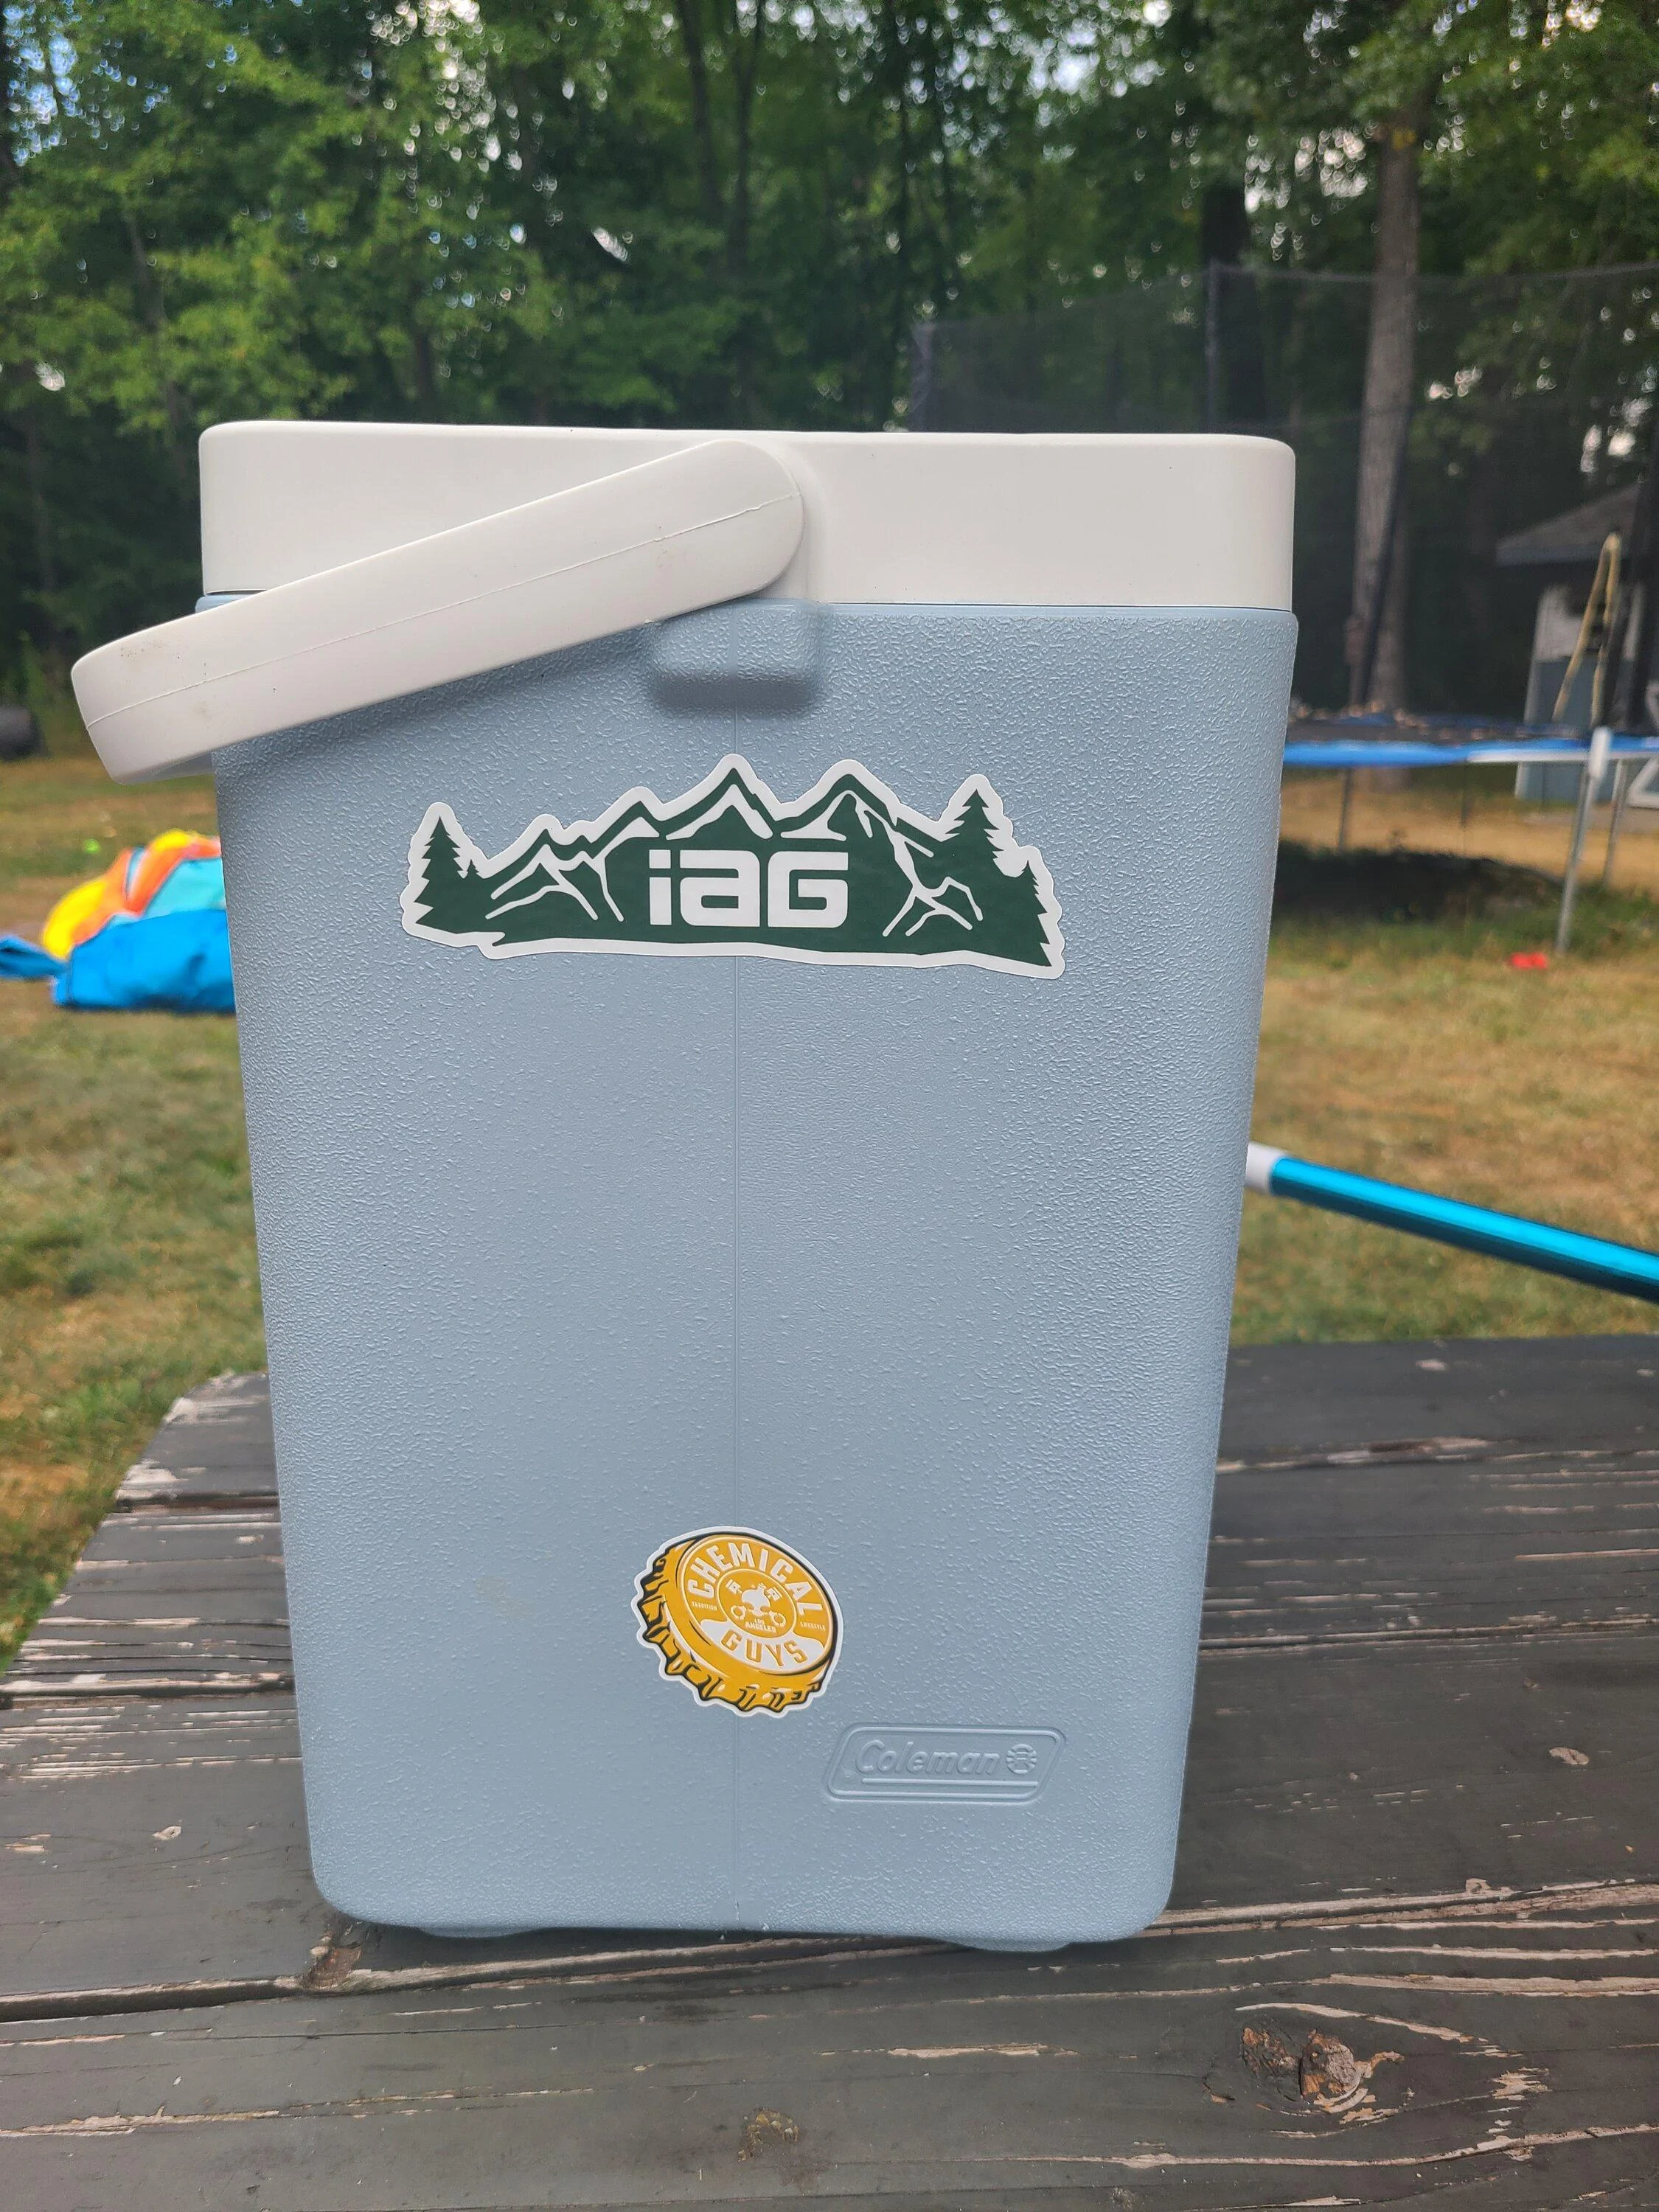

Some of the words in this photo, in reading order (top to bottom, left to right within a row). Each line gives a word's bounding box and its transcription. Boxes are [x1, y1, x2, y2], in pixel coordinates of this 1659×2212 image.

[687, 1542, 824, 1616] CHEMICAL
[691, 1601, 717, 1611] TRADITION
[745, 1621, 776, 1633] ANGELES
[720, 1628, 809, 1667] GUYS
[855, 1739, 1001, 1775] Coleman
